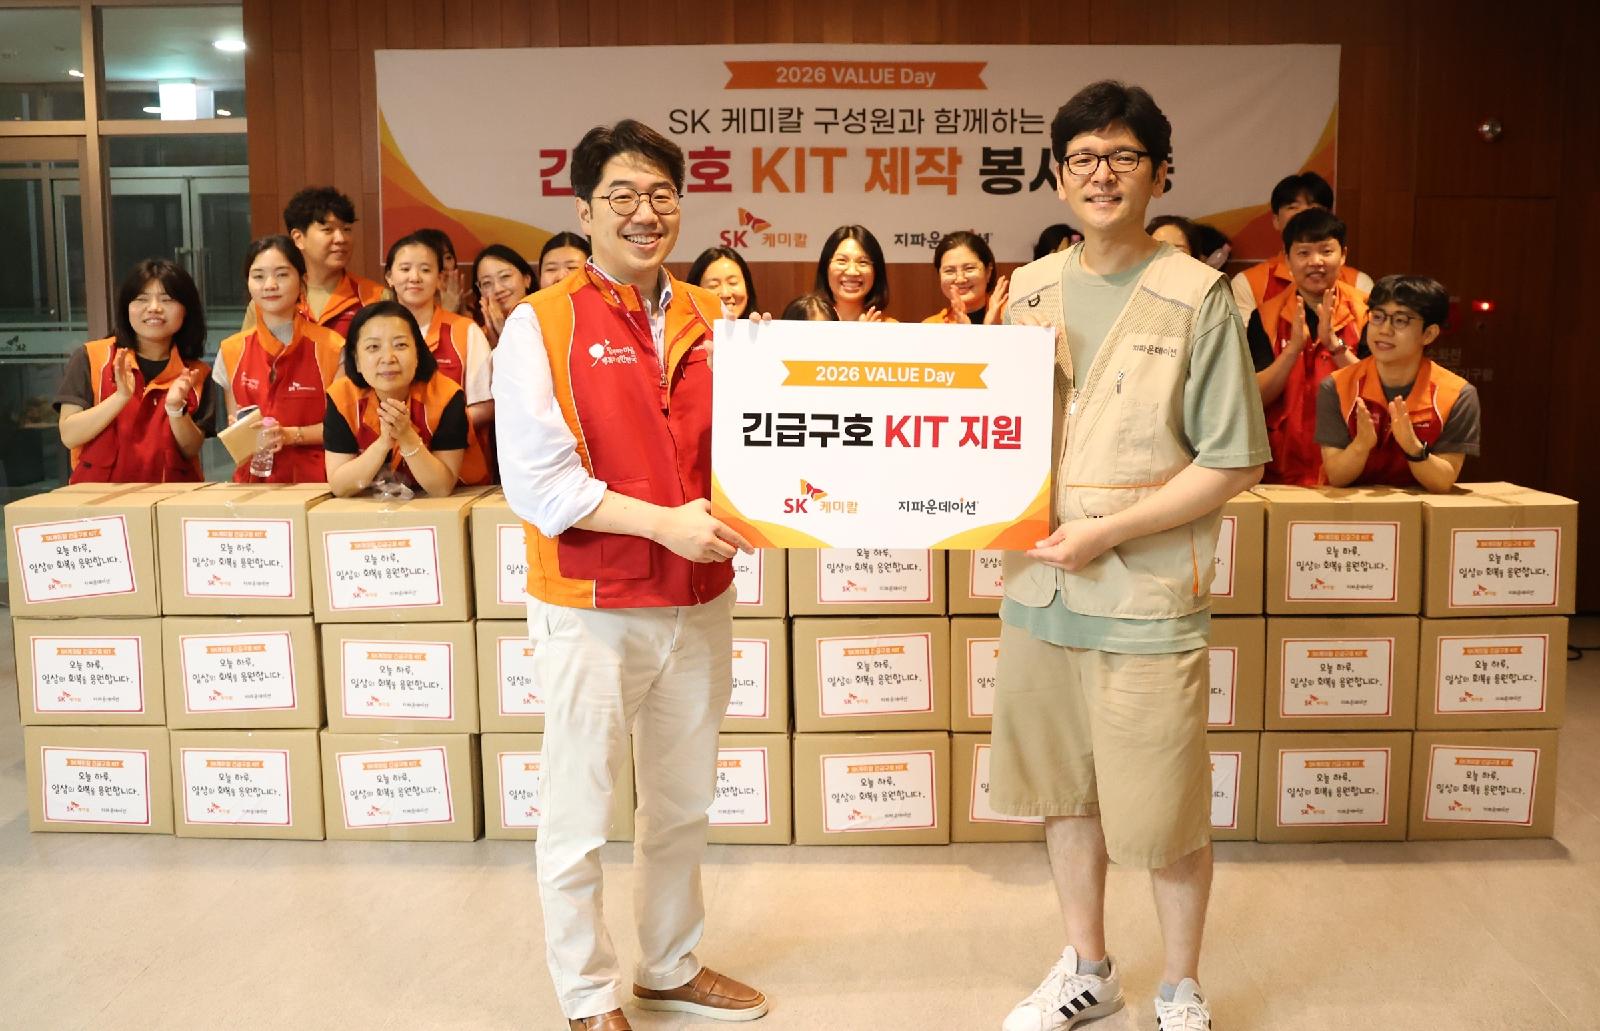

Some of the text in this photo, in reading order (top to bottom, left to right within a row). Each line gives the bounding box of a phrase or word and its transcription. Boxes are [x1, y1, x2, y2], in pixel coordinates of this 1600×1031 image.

[776, 66, 936, 88] 2026 VALUE Day
[668, 107, 1045, 136] SK 케미칼 구성원과 함께하는
[752, 146, 847, 194] KIT
[864, 145, 963, 195] 제작
[720, 230, 807, 248] SK 케미칼
[1132, 344, 1177, 358] 지파운데이션
[816, 366, 955, 386] 2026 VALUE Day
[742, 412, 1022, 450] 긴급구호 KIT 지원
[783, 498, 858, 514] SK 케미칼
[898, 497, 977, 515] 지파운데이션
[55, 545, 69, 557] 오늘
[220, 542, 233, 554] 오늘
[856, 547, 870, 559] 오늘
[1326, 546, 1339, 558] 오늘
[78, 556, 122, 569] 응원합니다.
[240, 557, 283, 569] 응원합니다.
[363, 554, 377, 566] 오늘
[1488, 552, 1501, 564] 오늘
[877, 561, 921, 574] 응원합니다.
[1345, 560, 1388, 572] 응원합니다.
[1507, 566, 1549, 578] 응원합니다.
[385, 566, 429, 579] 응원합니다.
[69, 660, 82, 671] 오늘
[219, 658, 233, 669] 오늘
[856, 660, 870, 672] 오늘
[1319, 662, 1333, 674] 오늘
[1474, 659, 1488, 671] 오늘
[240, 670, 284, 682] 응원합니다.
[379, 664, 392, 676] 오늘
[90, 673, 133, 685] 응원합니다.
[877, 672, 922, 685] 응원합니다.
[1339, 676, 1382, 688] 응원합니다.
[1493, 672, 1536, 684] 응원합니다.
[399, 679, 443, 690] 응원합니다.
[78, 771, 91, 782] 오늘
[218, 772, 231, 784] 오늘
[376, 773, 389, 785] 오늘
[1316, 772, 1330, 784] 오늘
[1465, 770, 1478, 782] 오늘
[860, 777, 874, 788] 오늘
[98, 785, 140, 796] 응원합니다.
[238, 786, 280, 797] 응원합니다.
[397, 785, 440, 798] 응원합니다.
[881, 789, 925, 802] 응원합니다.
[1335, 785, 1378, 797] 응원합니다.
[1483, 784, 1525, 795] 응원합니다.
